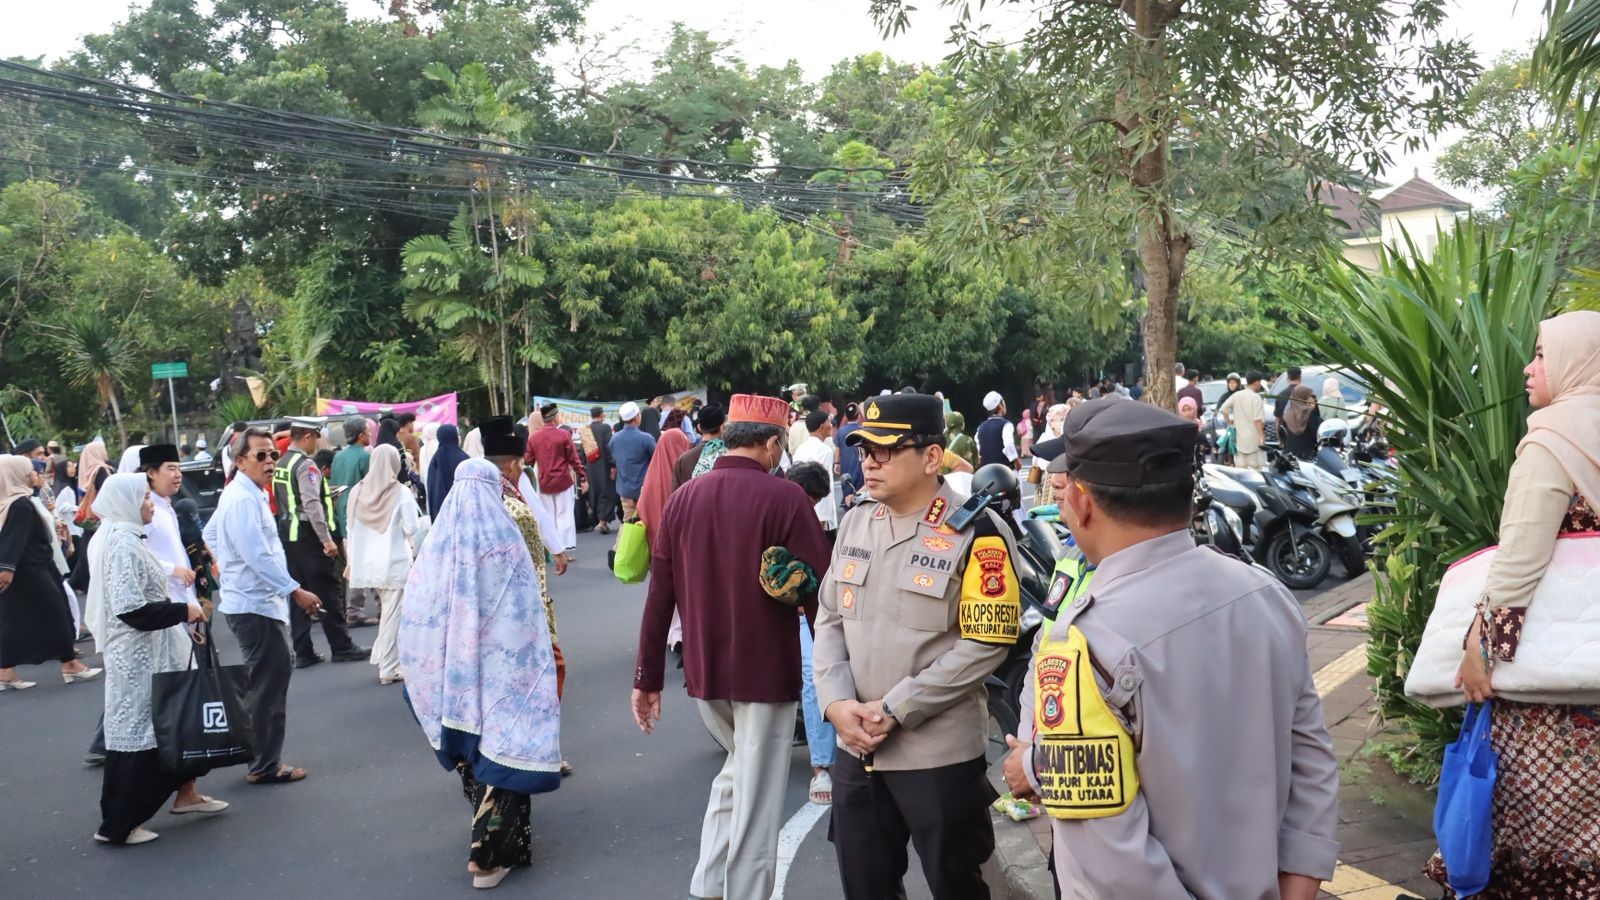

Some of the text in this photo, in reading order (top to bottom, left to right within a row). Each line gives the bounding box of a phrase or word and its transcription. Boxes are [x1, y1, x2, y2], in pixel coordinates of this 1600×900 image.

[910, 554, 952, 571] POLRI
[961, 603, 1019, 624] KA OPS RESTA
[973, 623, 1001, 635] KETUPAT
[1059, 776, 1081, 788] PURI
[1087, 775, 1115, 787] KAJA
[1078, 789, 1114, 801] UTARA
